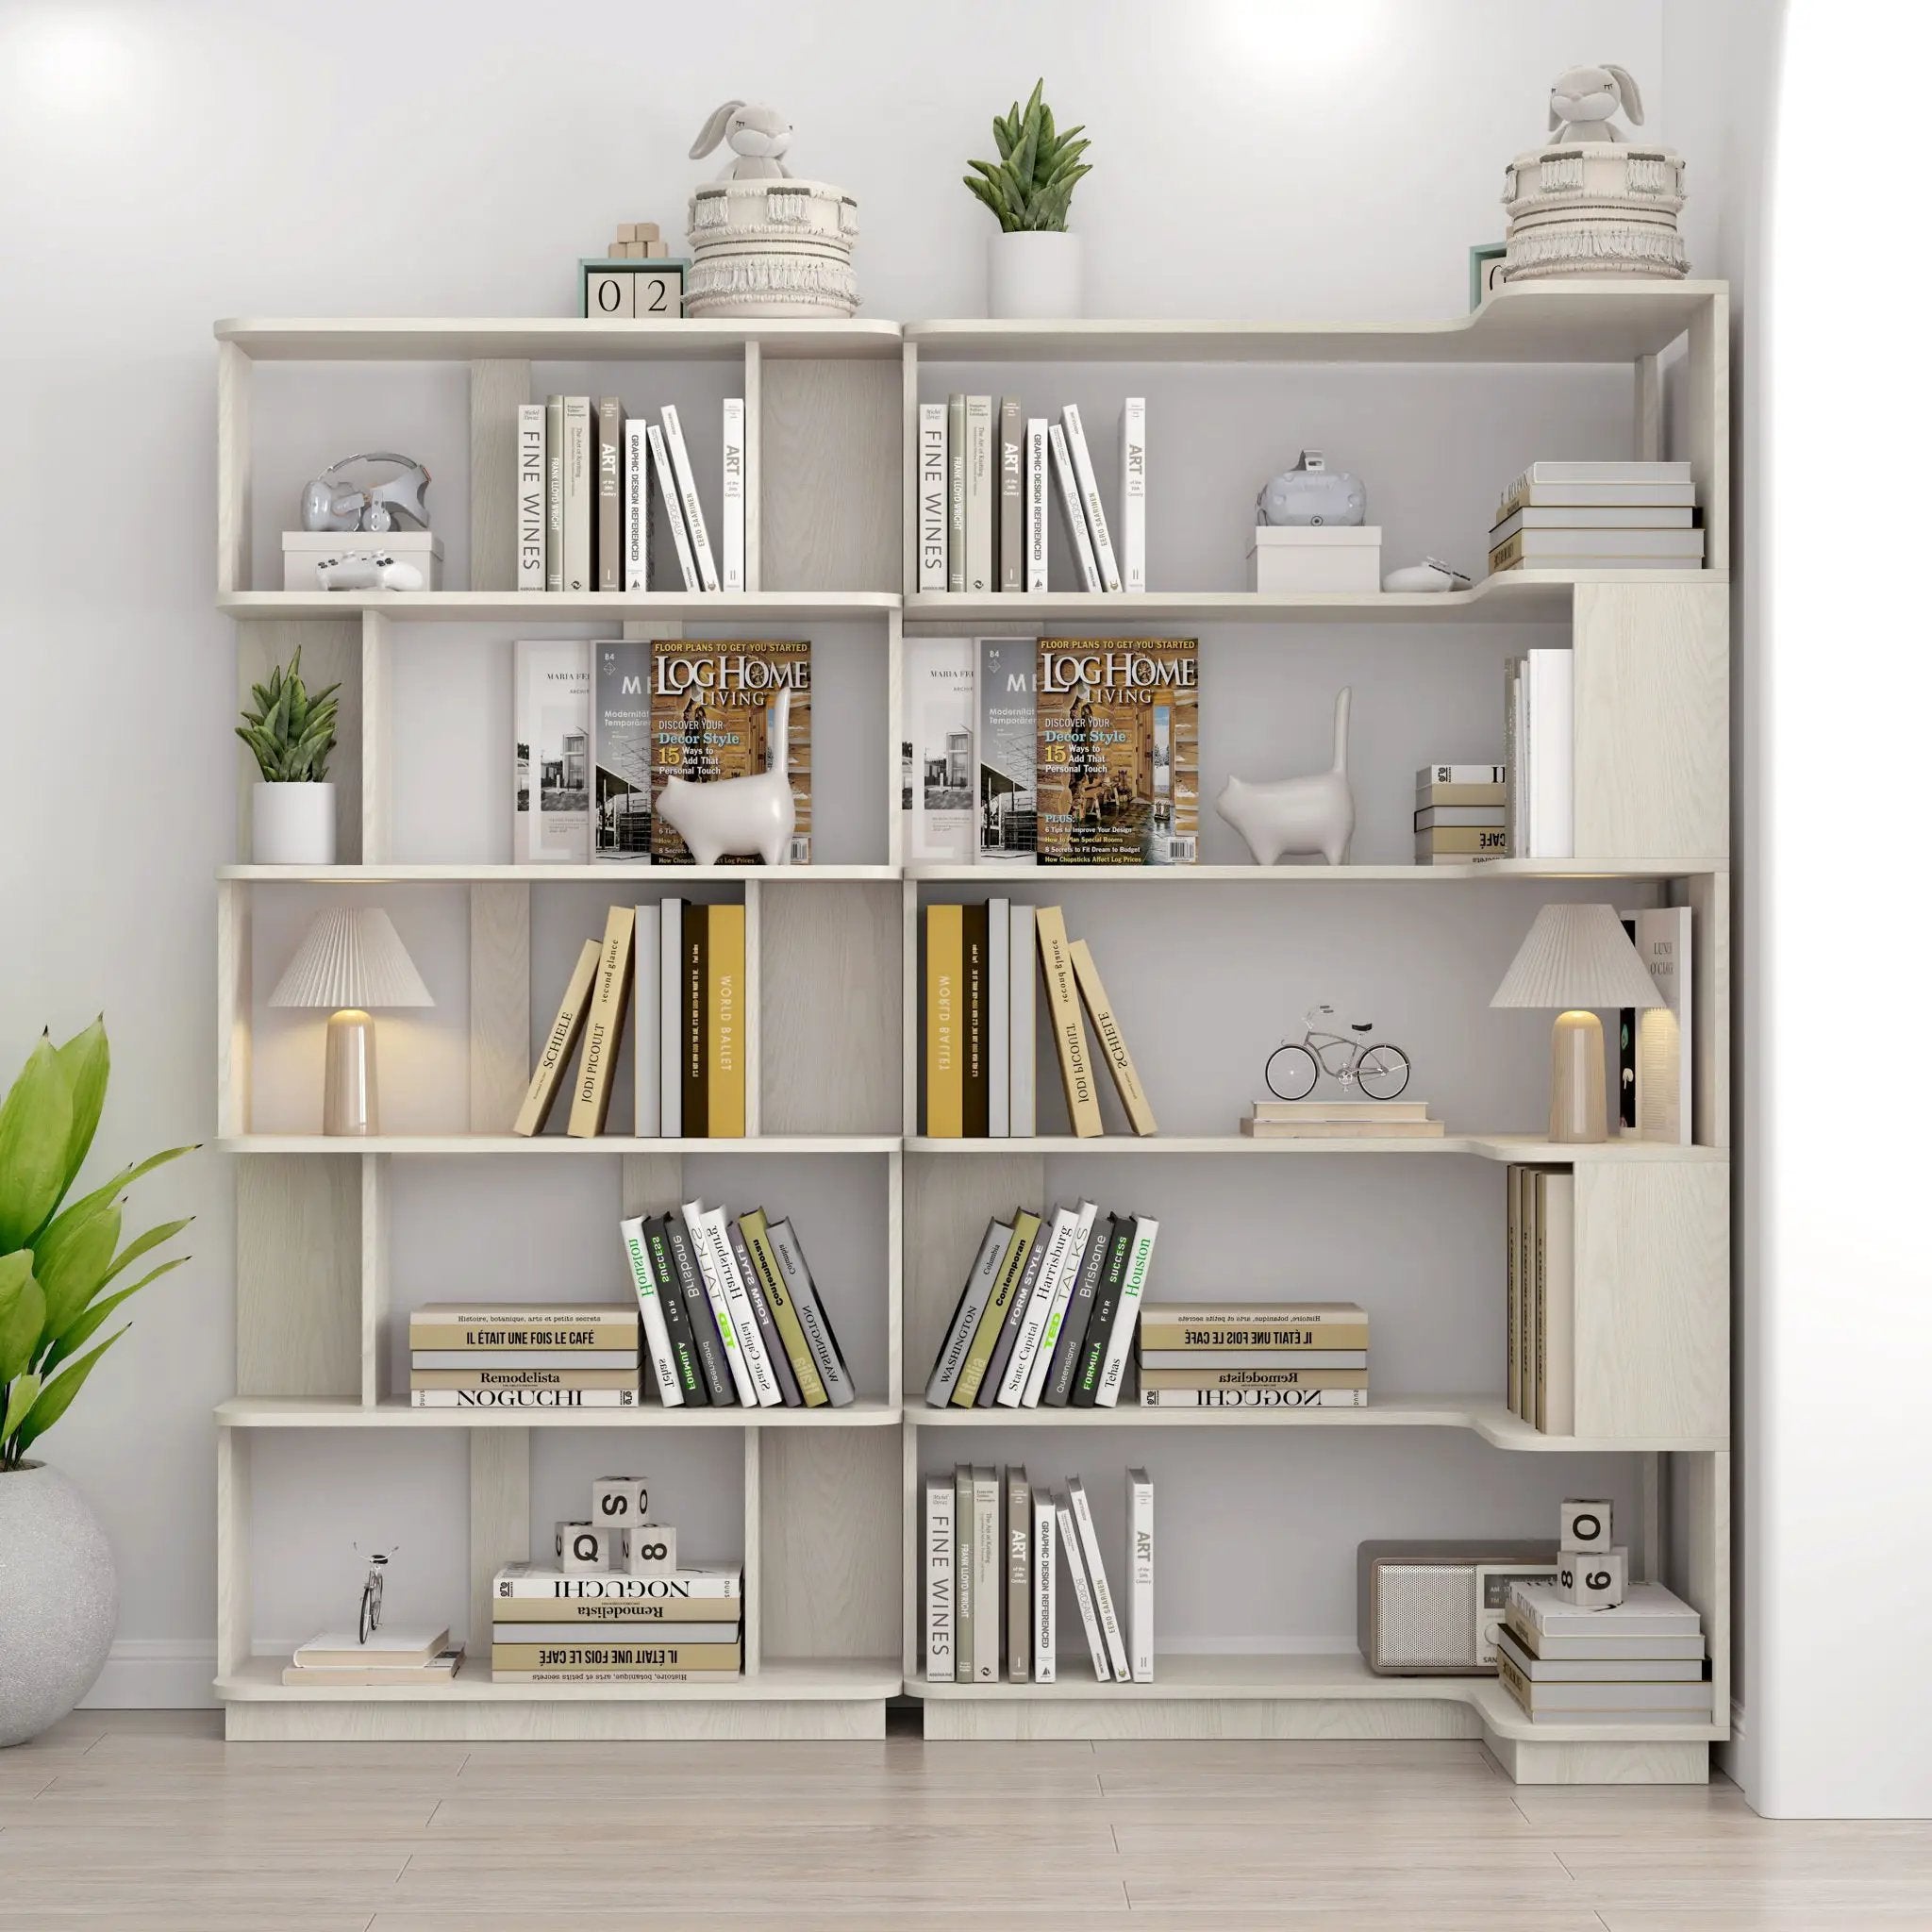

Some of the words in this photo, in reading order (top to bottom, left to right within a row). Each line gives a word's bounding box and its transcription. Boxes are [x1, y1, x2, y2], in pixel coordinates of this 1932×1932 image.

[523, 431, 541, 482] FINE
[602, 443, 616, 475] ART
[631, 435, 640, 472] GRAPHIC
[726, 445, 740, 475] ART
[924, 430, 942, 481] FINE
[1004, 442, 1019, 474] ART
[1128, 444, 1142, 475] ART
[631, 474, 640, 505] DESIGN
[687, 492, 700, 527] SAARINEN
[1089, 492, 1102, 526] SAARINEN
[523, 493, 541, 570] WINES
[631, 507, 640, 561] REFERENCED
[695, 529, 705, 547] EERO
[924, 492, 942, 569] WINES
[1097, 528, 1108, 546] EERO
[655, 643, 683, 652] FLOOR
[685, 643, 713, 652] PLANS
[717, 643, 727, 652] TO
[729, 643, 746, 652] GET
[749, 643, 766, 652] YOU
[769, 643, 808, 652] STARTED
[700, 691, 765, 706] LIVING
[1087, 689, 1152, 704] LIVING
[658, 721, 699, 730] DISCOVER
[701, 720, 724, 730] YOUR
[1044, 730, 1086, 742] Decor
[1090, 730, 1126, 745] Style
[1045, 718, 1085, 727] DISCOVER
[1088, 717, 1109, 727] YOUR
[659, 733, 699, 744] Decor
[703, 733, 740, 748] Style
[659, 747, 680, 765] 15
[682, 747, 703, 756] Ways
[1044, 744, 1067, 763] 15
[1069, 744, 1090, 754] Ways
[682, 757, 698, 765] Add
[701, 757, 719, 765] That
[1045, 764, 1081, 773] Personal
[1083, 764, 1108, 773] Touch
[1068, 755, 1085, 763] Add
[1087, 755, 1106, 763] That
[1044, 814, 1076, 824] PLUS:
[601, 972, 612, 1003] second
[608, 940, 619, 969] glance
[720, 975, 733, 1021] WORLD
[542, 1011, 574, 1069] SCHIELE
[586, 1024, 605, 1074] PICOULT
[720, 1027, 733, 1072] BALLET
[581, 1076, 595, 1104] JODI
[983, 1243, 1001, 1275] Columbia
[996, 1240, 1026, 1307] Contemporan
[1037, 1225, 1074, 1300] Harrisburg
[1058, 1227, 1088, 1302] TALKS
[1079, 1235, 1106, 1298] Brisbane
[1124, 1238, 1151, 1298] Houston
[1010, 1289, 1028, 1325] FORM
[1024, 1244, 1043, 1285] STYLE
[1084, 1342, 1102, 1391] FORMULA
[1101, 1300, 1110, 1322] FOR
[1110, 1237, 1126, 1283] SUCCESS
[467, 1332, 475, 1344] IL
[477, 1329, 506, 1344] ÉTAIT
[508, 1332, 527, 1344] UNE
[530, 1332, 552, 1344] FOIS
[555, 1332, 566, 1344] LE
[569, 1329, 594, 1344] CAFÉ
[941, 1306, 977, 1383] WASHINGTON
[1009, 1359, 1024, 1391] State
[1019, 1322, 1039, 1359] Capital
[1057, 1341, 1076, 1393] Queensland
[480, 1372, 560, 1383] Remodelista
[958, 1357, 987, 1396] Italia
[457, 1390, 583, 1406] NOGUCHI
[602, 1494, 627, 1515] S
[574, 1534, 598, 1562] Q
[641, 1543, 668, 1560] 8
[932, 1515, 949, 1567] FINE
[1011, 1530, 1026, 1561] ART
[1041, 1521, 1049, 1558] GRAPHIC
[1137, 1531, 1151, 1562] ART
[554, 1580, 691, 1598] NOGUCHI
[1041, 1560, 1049, 1591] DESIGN
[1097, 1579, 1111, 1612] SAARINEN
[577, 1607, 664, 1619] Remodelista
[932, 1578, 949, 1656] WINES
[1041, 1593, 1049, 1648] REFERENCED
[1107, 1615, 1115, 1634] EERO
[539, 1651, 566, 1667] CAFÉ
[570, 1651, 582, 1663] LE
[585, 1651, 608, 1663] FOIS
[611, 1651, 632, 1663] UNE
[636, 1651, 665, 1667] ÉTAIT
[668, 1651, 677, 1663] IL
